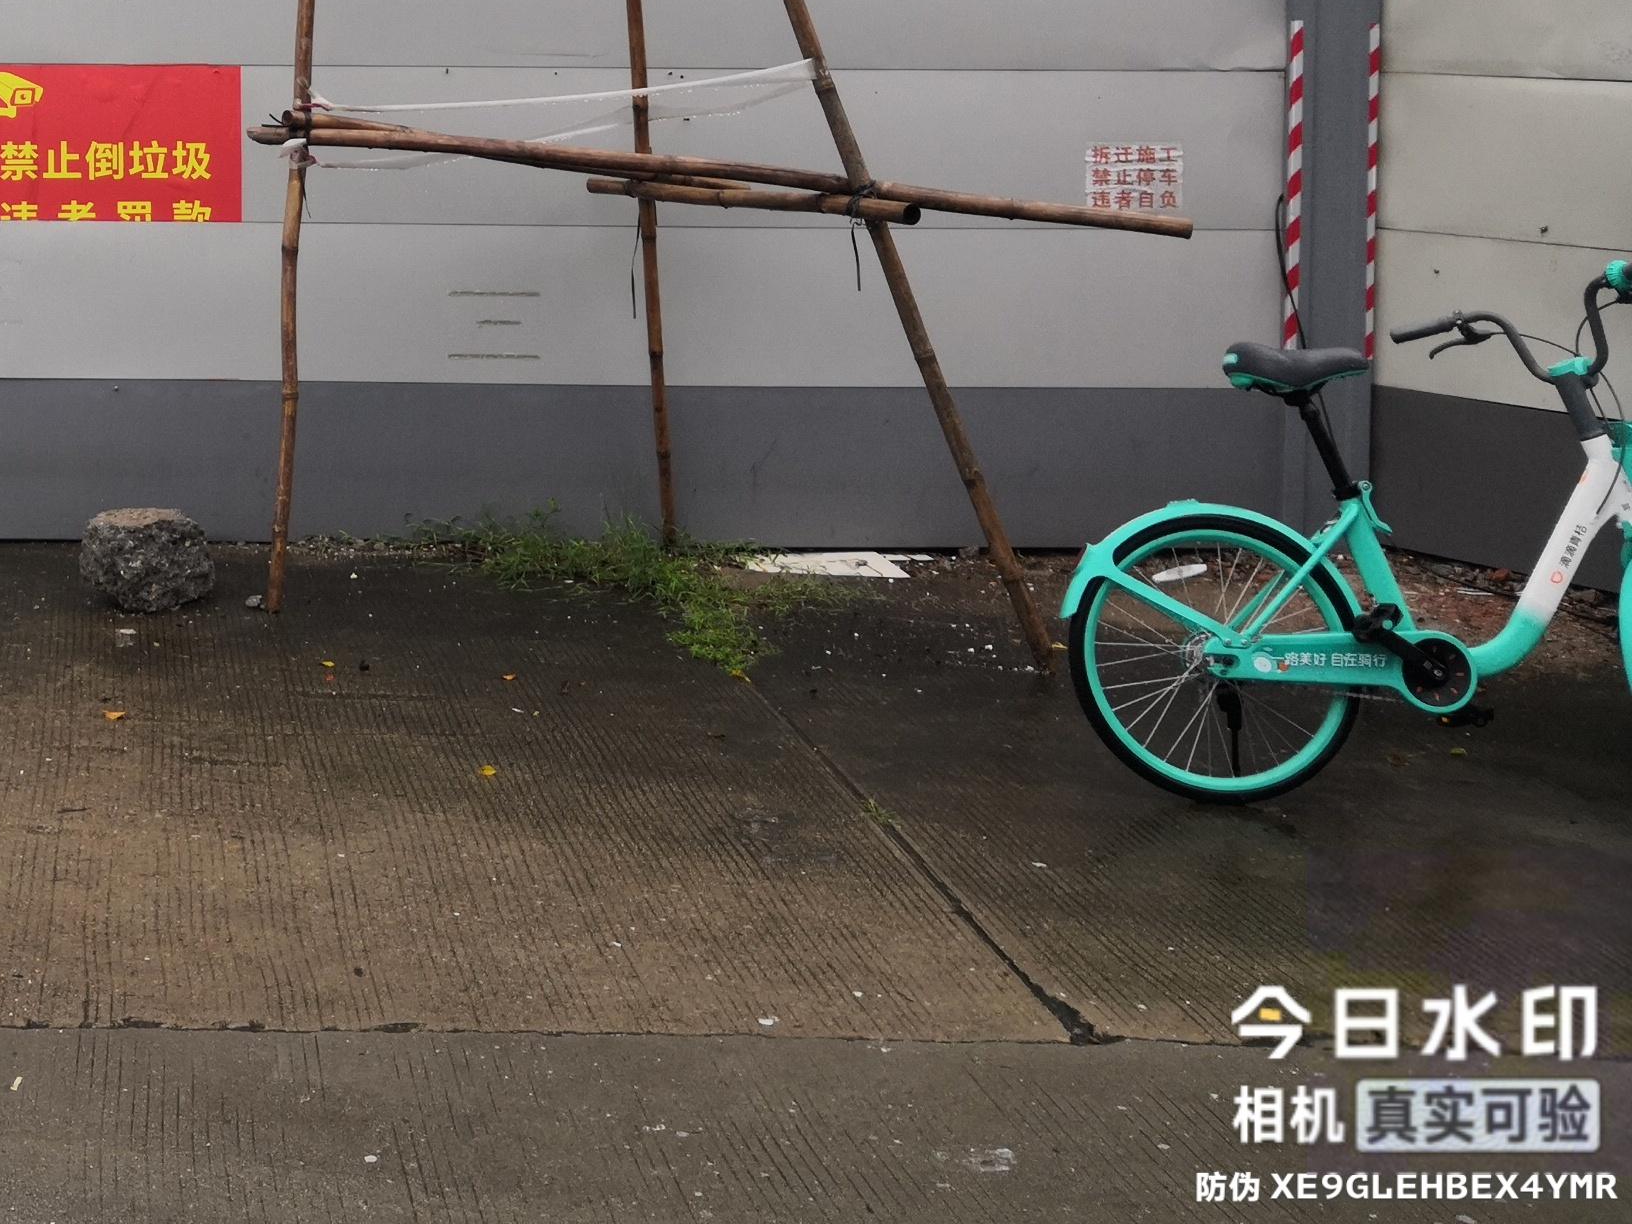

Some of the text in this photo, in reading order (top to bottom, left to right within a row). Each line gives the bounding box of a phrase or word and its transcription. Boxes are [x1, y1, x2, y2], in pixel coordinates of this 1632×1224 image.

[0, 140, 213, 182] 禁止倒垃圾
[1090, 167, 1178, 187] 禁止停车
[1090, 189, 1179, 210] 违者自负
